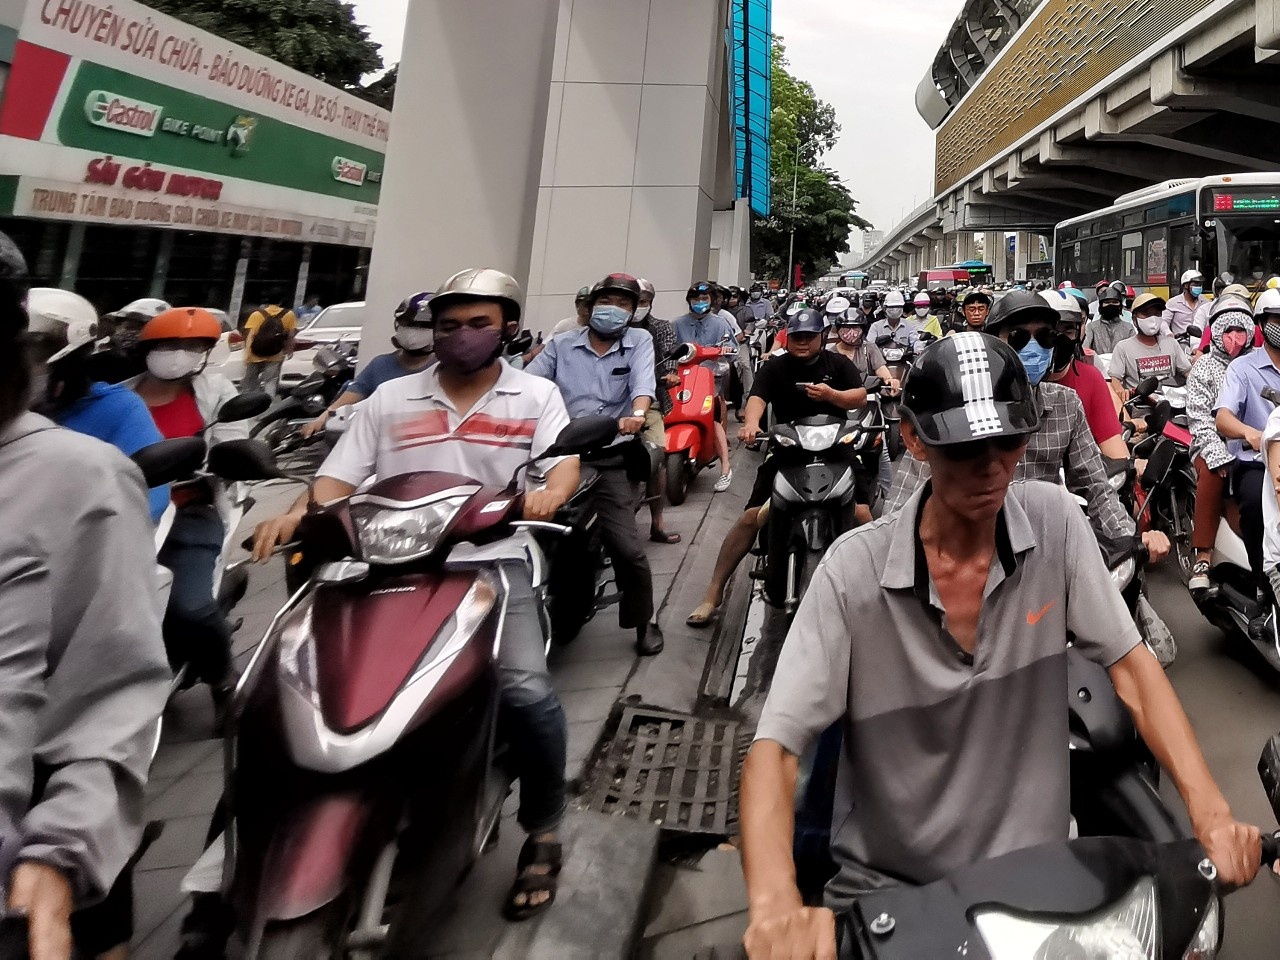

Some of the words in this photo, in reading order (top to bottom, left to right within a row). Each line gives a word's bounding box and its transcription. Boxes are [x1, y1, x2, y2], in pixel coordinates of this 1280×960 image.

[106, 98, 158, 132] Castrol
[279, 81, 296, 108] XE
[311, 94, 327, 119] XE
